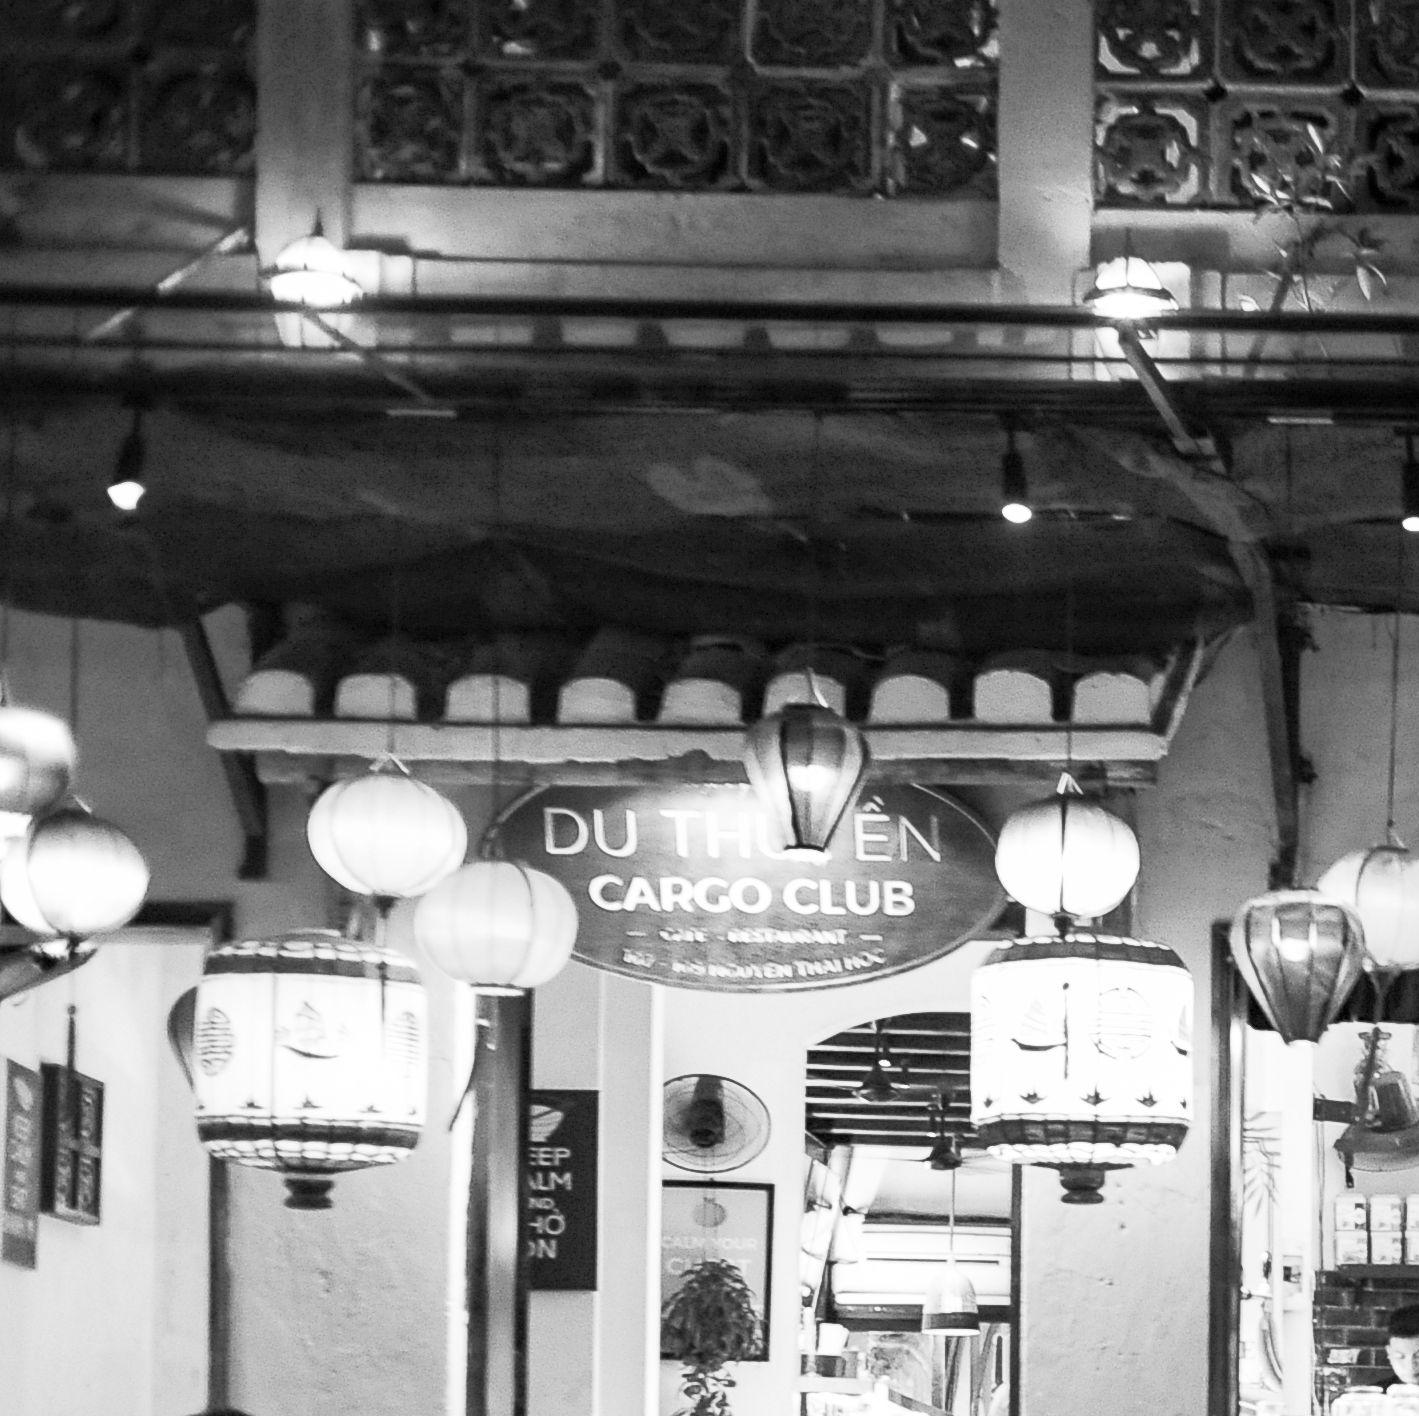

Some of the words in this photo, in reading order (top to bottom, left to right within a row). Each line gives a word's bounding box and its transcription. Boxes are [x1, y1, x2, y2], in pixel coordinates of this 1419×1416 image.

[543, 807, 637, 858] DU
[588, 874, 773, 913] CARGO
[782, 878, 915, 916] CLUB
[528, 1147, 571, 1166] EEP
[527, 1171, 573, 1191] LM
